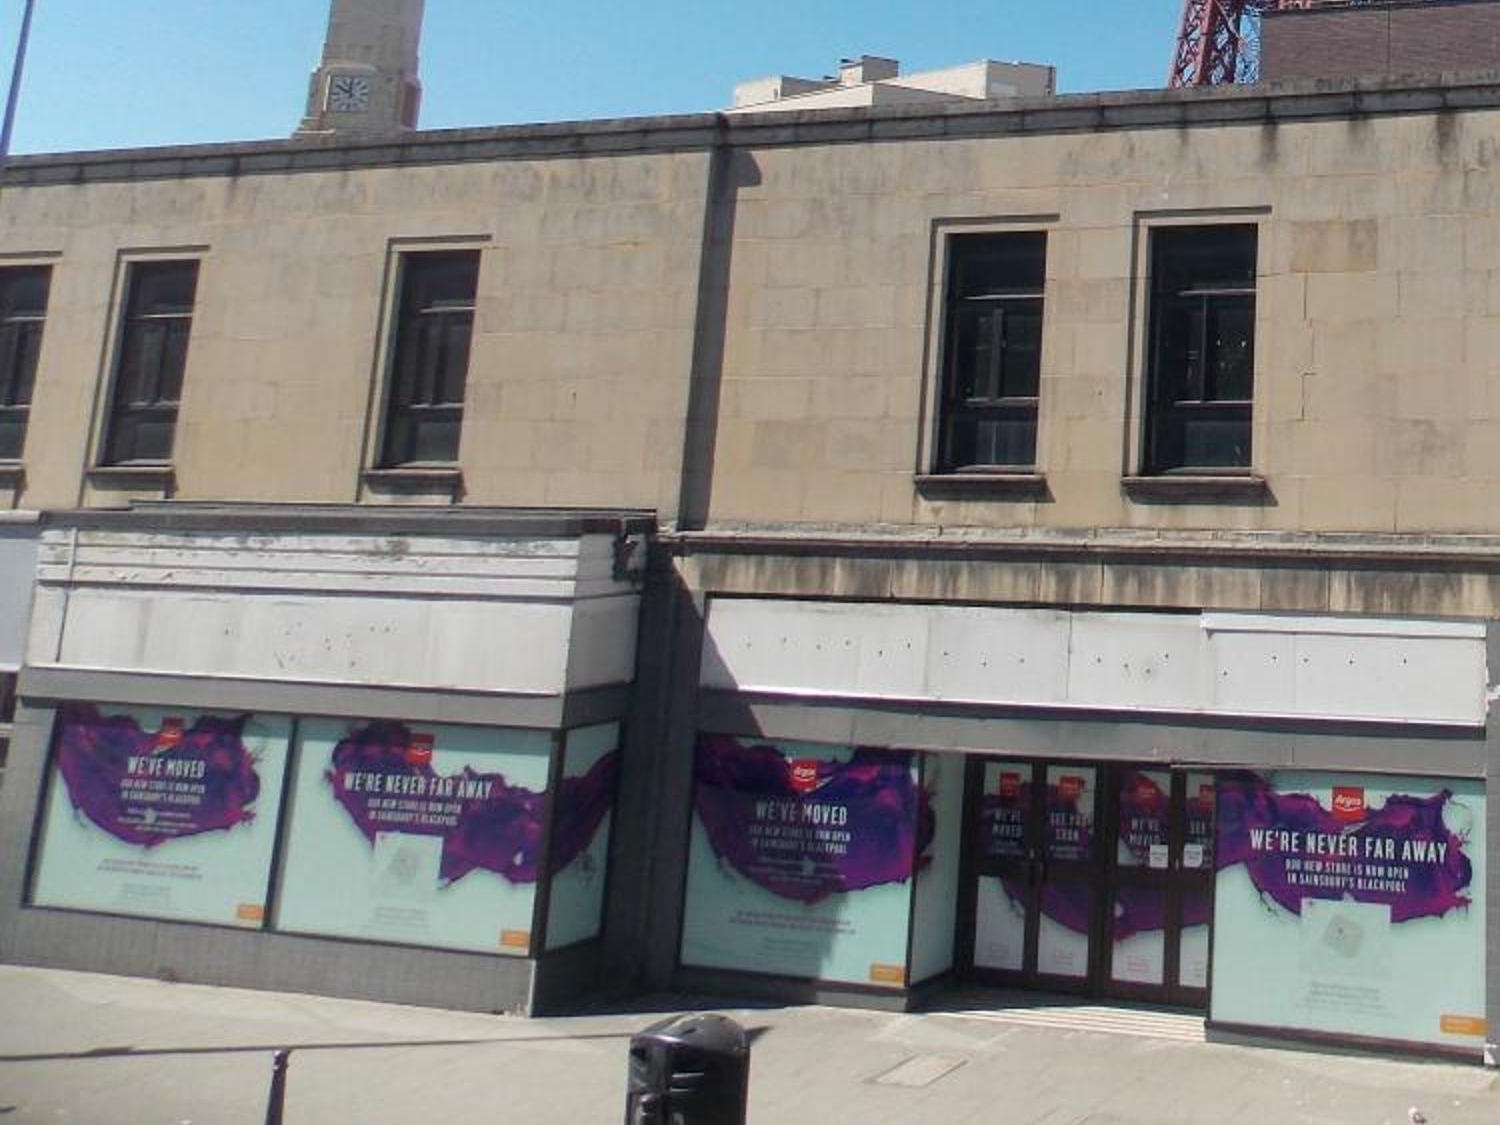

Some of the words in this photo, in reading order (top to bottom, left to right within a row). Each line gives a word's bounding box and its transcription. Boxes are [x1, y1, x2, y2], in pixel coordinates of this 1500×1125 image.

[128, 757, 164, 776] WE'VE
[167, 759, 206, 779] MOVED
[344, 773, 382, 791] WE'RE
[385, 775, 426, 795] NEVER
[430, 778, 454, 797] FAR
[456, 779, 493, 799] AWAY
[1334, 794, 1362, 807] Argos
[756, 801, 796, 821] WE'VE
[802, 803, 848, 825] MOVED
[1250, 829, 1300, 853] WE'RE
[1306, 833, 1358, 857] NEVER
[1365, 837, 1396, 859] FAR
[1402, 840, 1448, 864] AWAY
[1304, 859, 1322, 872] NEW
[1325, 861, 1350, 875] STORE
[1354, 864, 1363, 875] IS
[1366, 865, 1384, 877] NOW
[1388, 866, 1409, 879] OPEN
[1288, 873, 1298, 884] IN
[1357, 878, 1407, 893] BLACKPOOL
